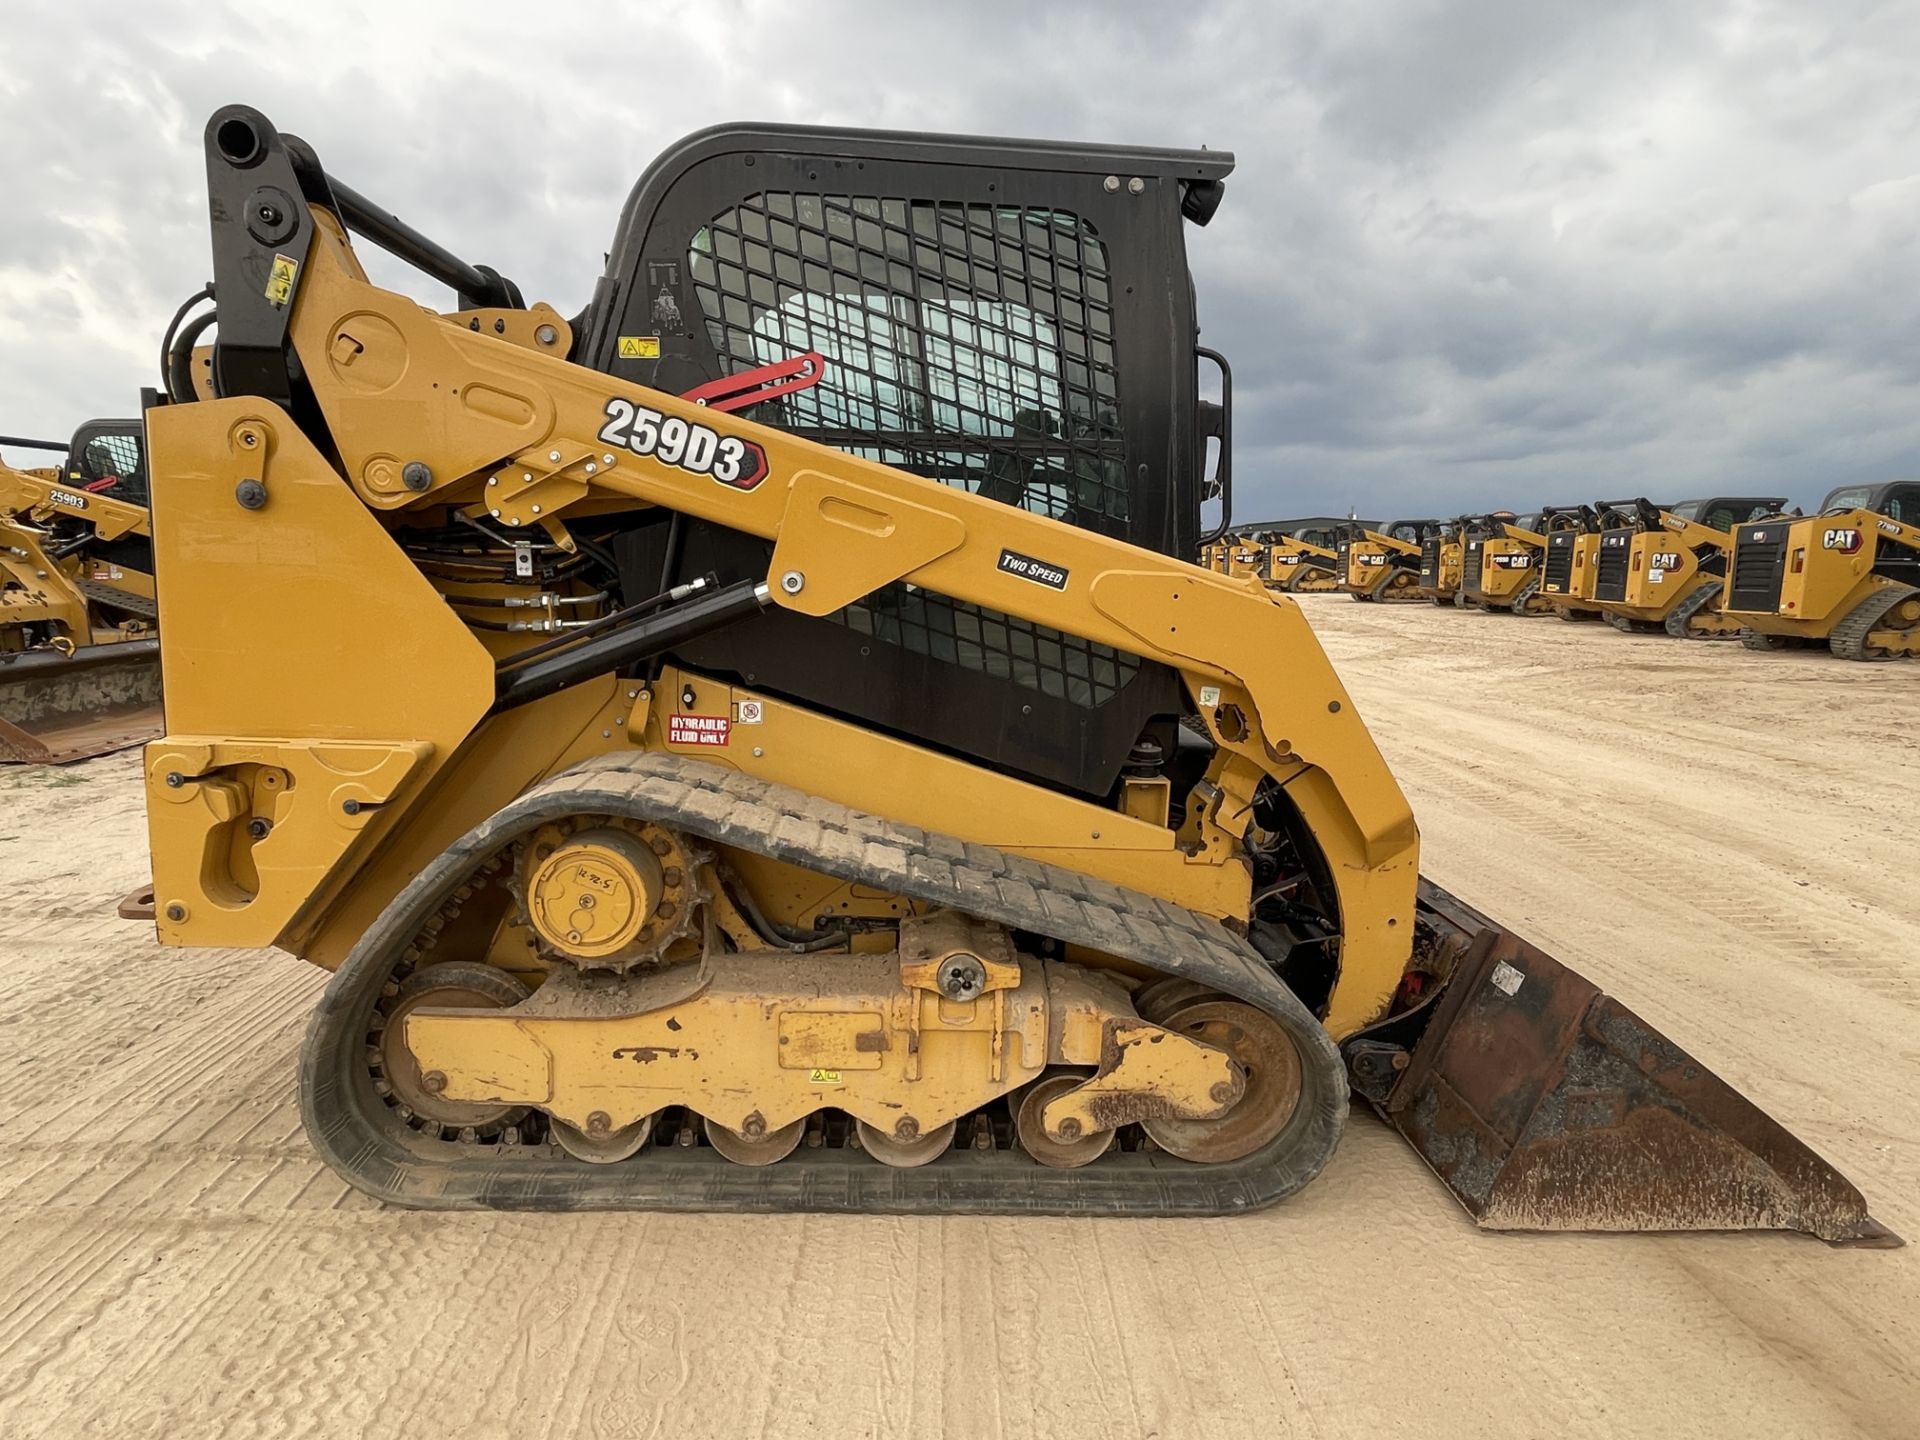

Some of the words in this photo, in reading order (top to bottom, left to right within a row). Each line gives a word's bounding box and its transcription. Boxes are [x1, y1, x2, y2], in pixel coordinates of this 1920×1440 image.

[600, 399, 746, 482] 259D3
[50, 490, 84, 508] 259D3
[1824, 529, 1856, 549] CAT
[1370, 555, 1385, 565] CAT
[1511, 556, 1529, 568] CAT
[1652, 553, 1677, 568] CAT
[1002, 554, 1028, 572] TWO
[1027, 563, 1064, 584] SPEED
[671, 716, 727, 731] HYDRAULIC
[670, 730, 698, 742] FLUID
[699, 732, 726, 744] ONLY
